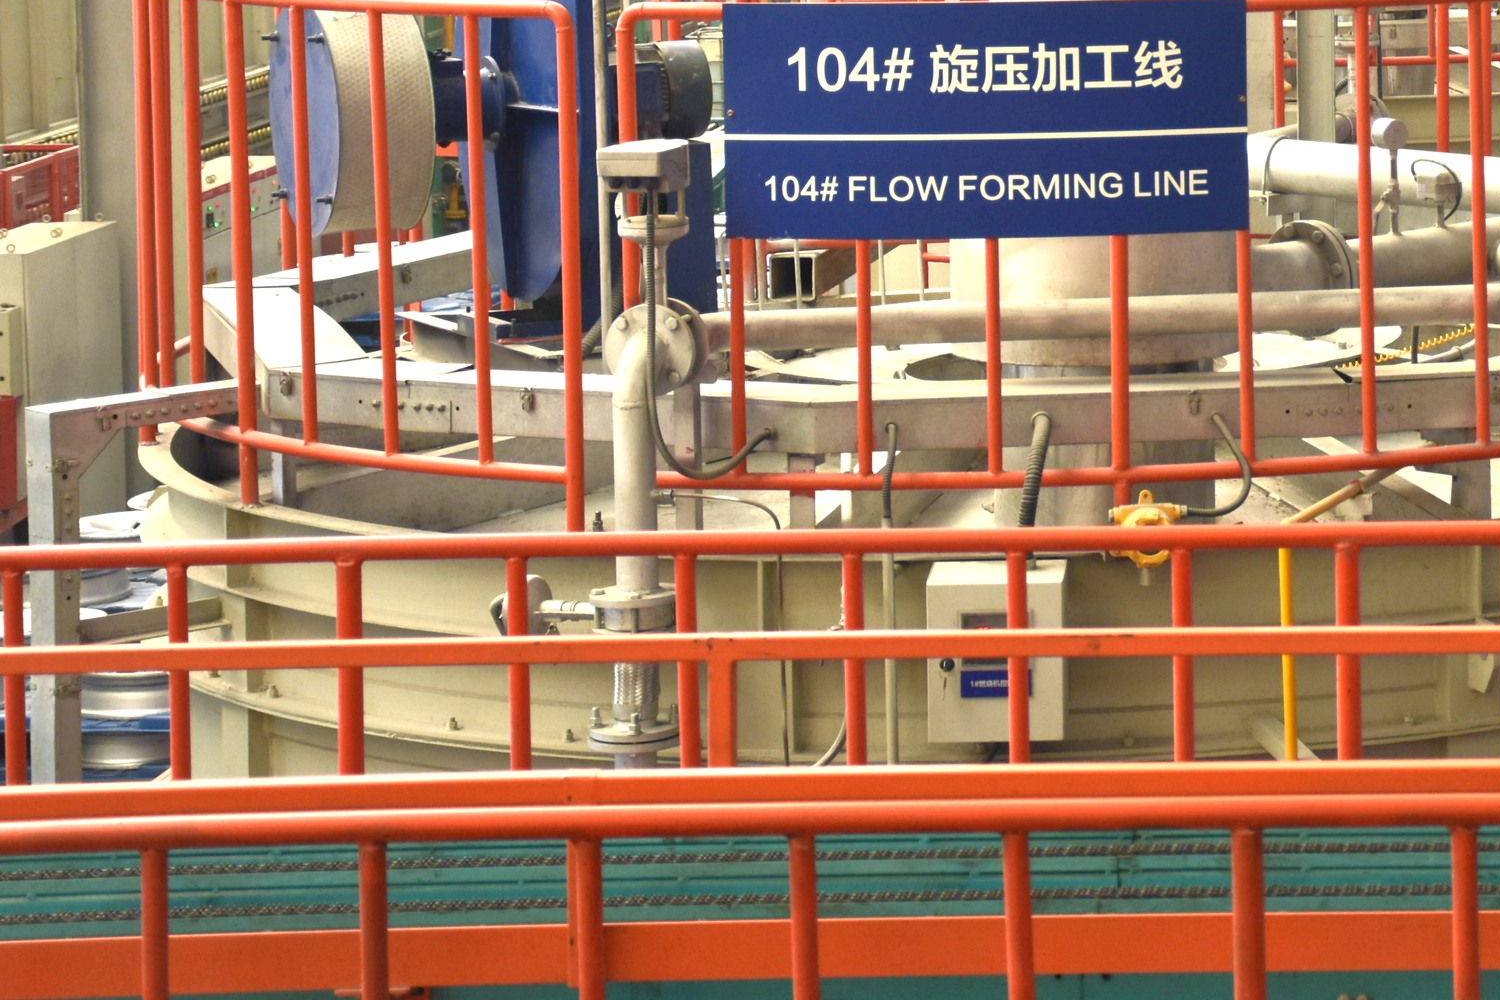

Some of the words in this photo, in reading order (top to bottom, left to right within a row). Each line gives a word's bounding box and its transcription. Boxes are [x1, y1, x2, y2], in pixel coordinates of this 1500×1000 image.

[787, 45, 914, 92] 104#
[929, 40, 1184, 94] 旋压加工线
[764, 175, 839, 202] 104#
[848, 175, 949, 202] FLOW
[958, 171, 1124, 201] FORMING
[1134, 169, 1209, 198] LINE
